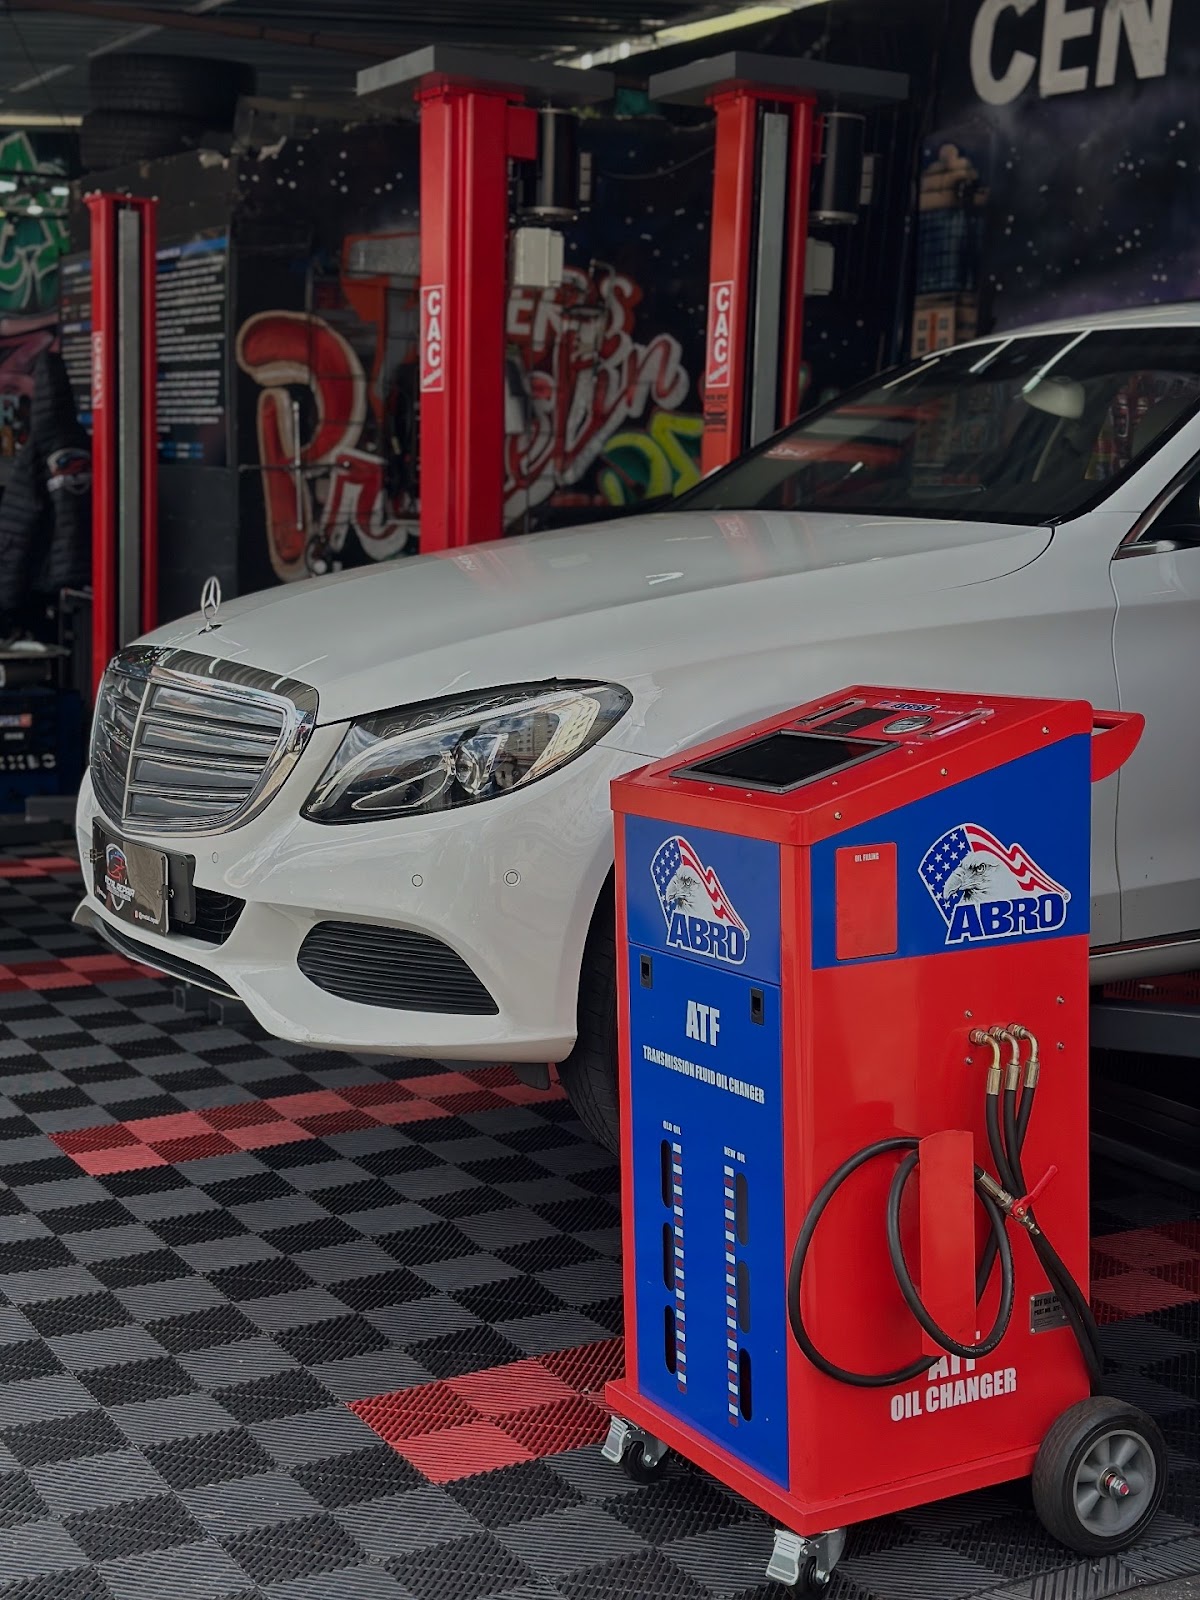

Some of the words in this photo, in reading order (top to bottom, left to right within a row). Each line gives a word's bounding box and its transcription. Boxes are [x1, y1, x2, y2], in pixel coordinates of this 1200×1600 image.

[427, 290, 441, 367] CAC
[714, 286, 730, 363] CAC
[667, 911, 746, 963] ABRO
[948, 893, 1066, 943] ABRO
[685, 999, 720, 1047] ATF
[642, 1044, 695, 1078] TRANSMISSION
[695, 1064, 716, 1086] FLUID
[716, 1072, 729, 1091] OIL
[728, 1076, 765, 1105] CHANGER
[662, 1119, 673, 1132] OLD
[673, 1124, 682, 1136] OIL
[723, 1145, 736, 1160] NEW
[736, 1151, 746, 1164] OIL
[890, 1390, 923, 1422] OIL
[925, 1367, 1017, 1413] CHANGER
